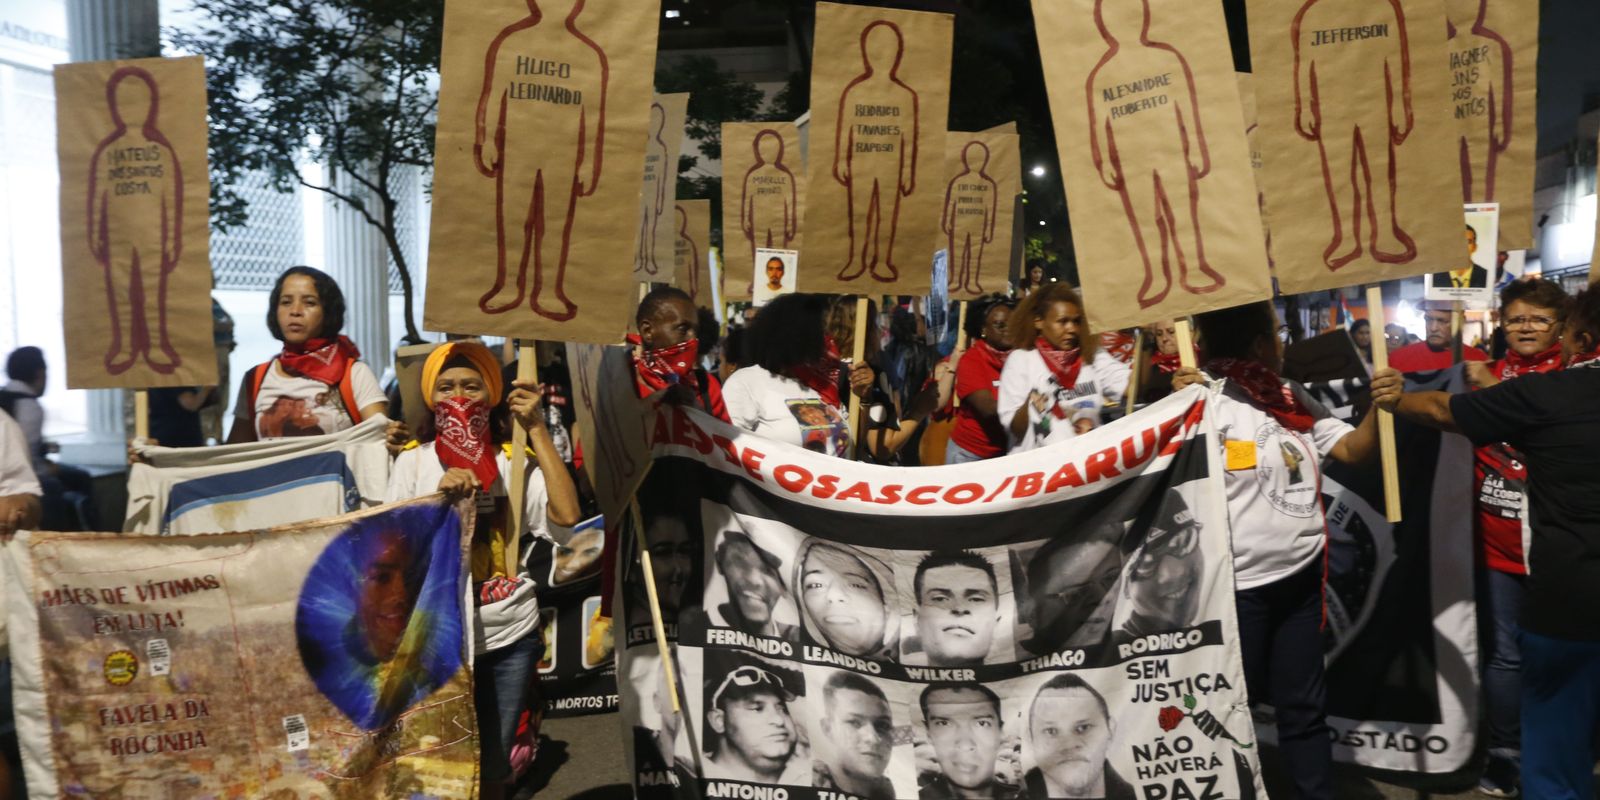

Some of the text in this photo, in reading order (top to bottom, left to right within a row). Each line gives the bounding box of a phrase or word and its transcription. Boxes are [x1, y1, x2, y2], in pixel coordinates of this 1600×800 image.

[1311, 23, 1389, 46] JEFFERSON
[515, 55, 571, 79] HUGO
[1450, 45, 1492, 70] AGNER
[509, 81, 582, 105] LEONARDO
[1103, 72, 1173, 103] ALEXANDRE
[1111, 94, 1169, 119] ROBERTO
[857, 124, 901, 136] TAVARES
[107, 145, 160, 166] MATEUS
[855, 142, 894, 153] RAPOSO
[115, 181, 152, 196] COSTA
[43, 574, 220, 607] MÃES DE VÍTIMAS
[707, 628, 1203, 683] FERNANDO LEANDRO WILKER THIAGO RODRIGO
[1126, 659, 1170, 680] SEM
[1131, 673, 1233, 703] JUSTIÇA
[100, 699, 210, 727] FAVELA DA
[556, 695, 604, 710] MORTOS
[111, 730, 207, 756] ROCINHA
[1132, 736, 1193, 763] NÃO
[1136, 752, 1223, 780] HAVERÁ
[706, 782, 789, 800] ANTONIO
[1142, 774, 1225, 800] PAZ
